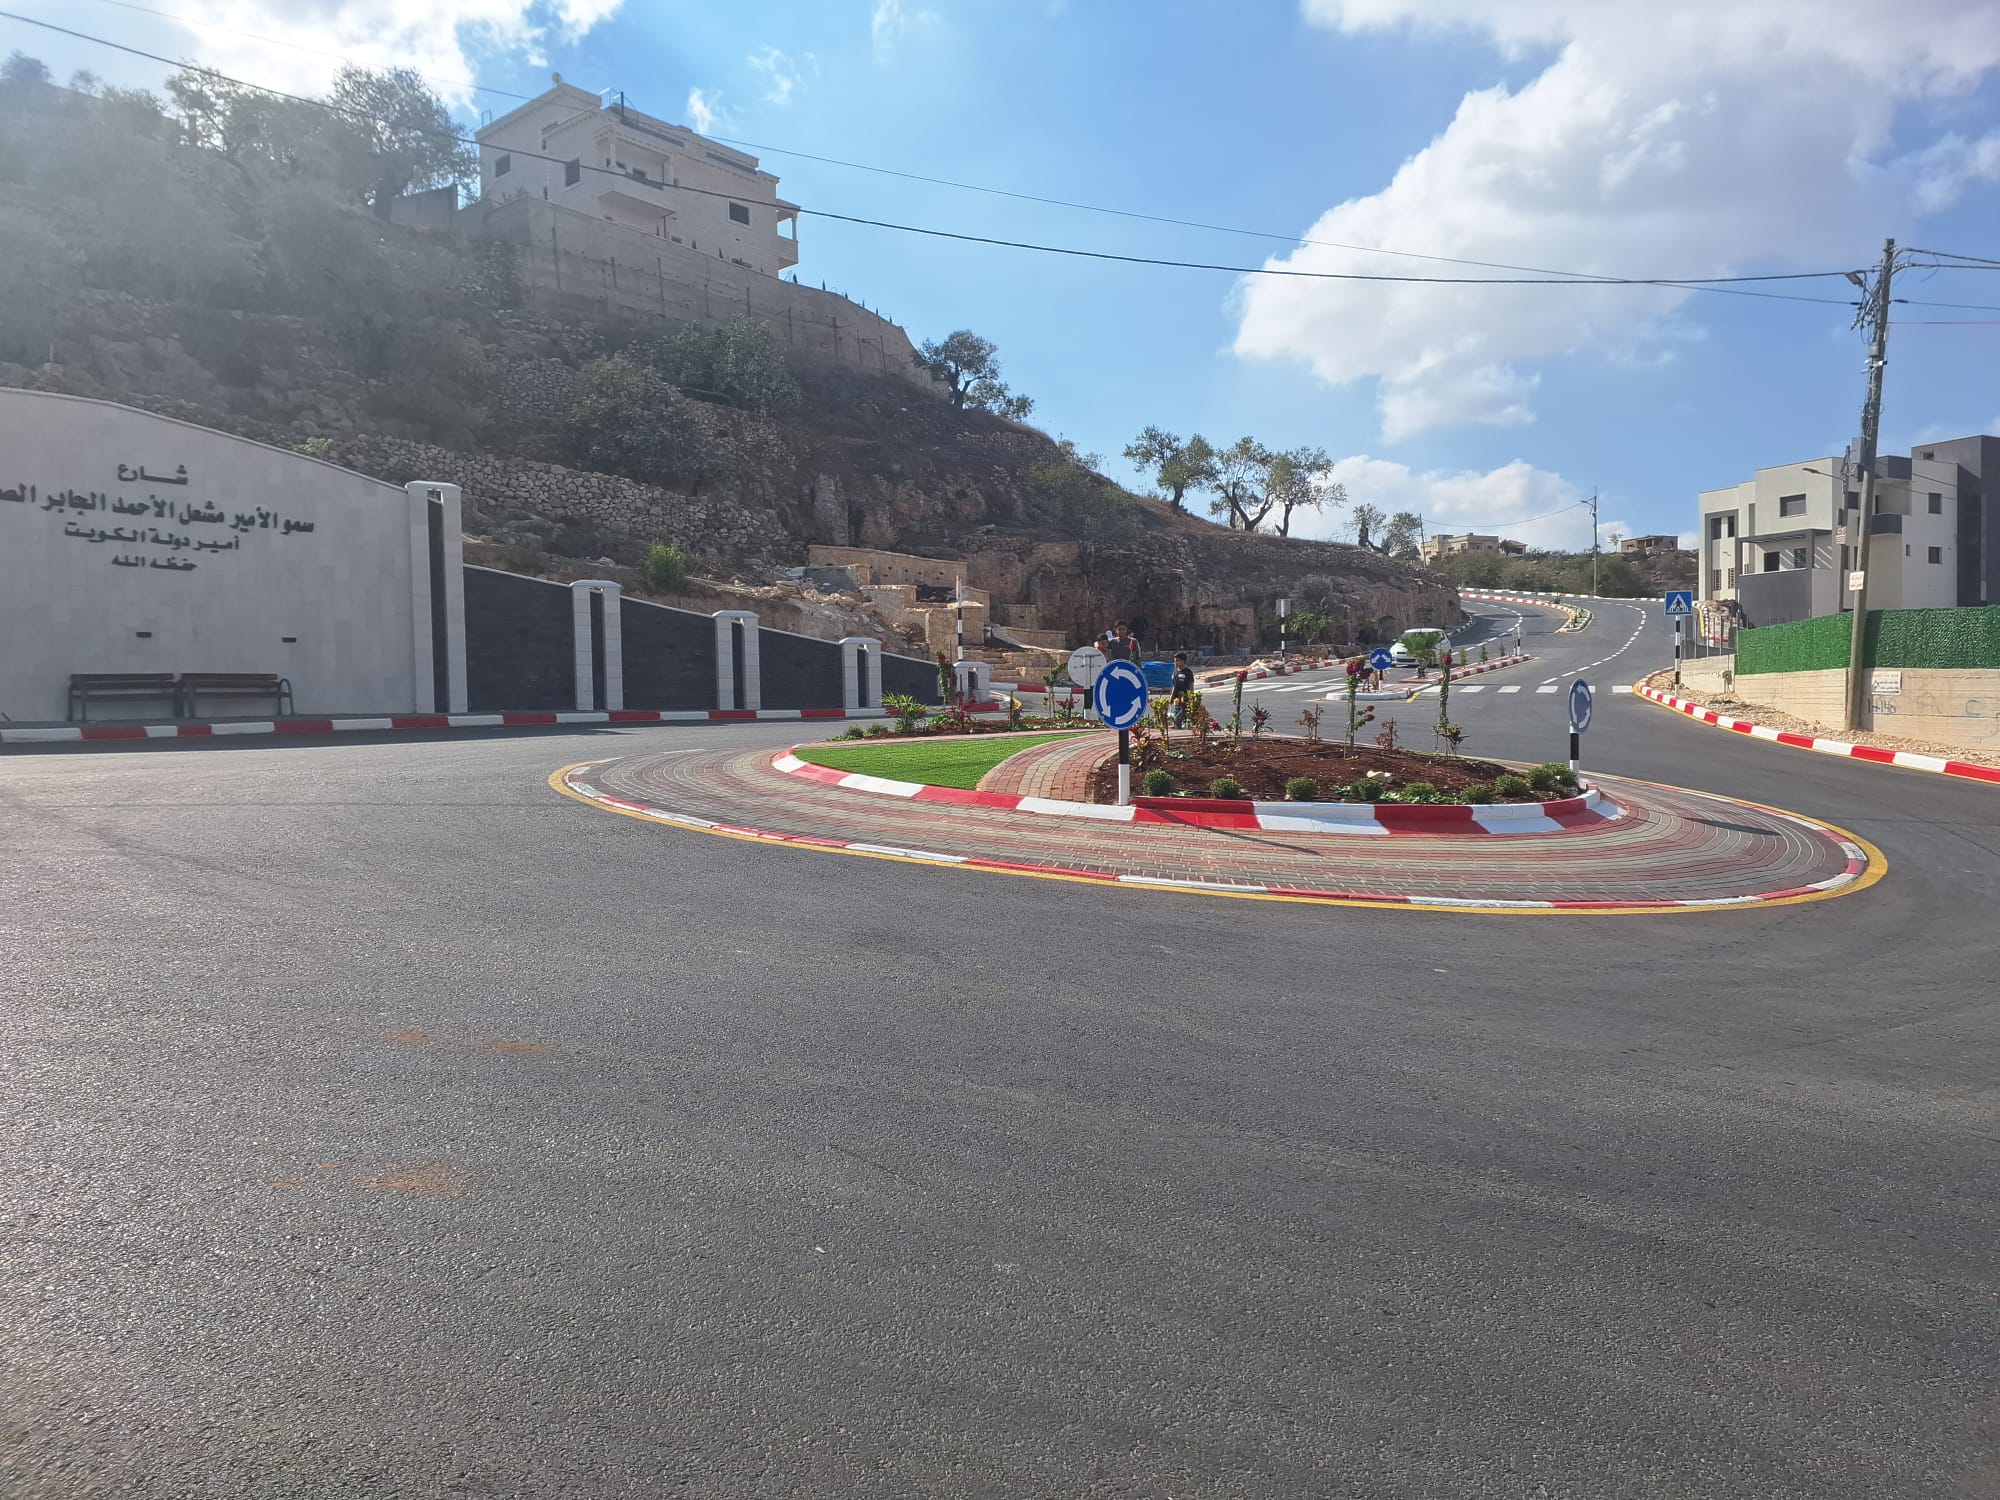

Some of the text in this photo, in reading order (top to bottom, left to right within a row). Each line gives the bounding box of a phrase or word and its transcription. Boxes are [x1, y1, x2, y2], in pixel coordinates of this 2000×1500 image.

[117, 463, 188, 486] شارع
[40, 488, 106, 516] الجابر
[112, 494, 174, 518] الأحمد
[179, 500, 225, 525] مشعل
[228, 505, 278, 533] الأمير
[279, 518, 314, 535] سمو
[65, 521, 239, 554] أمير دولة الكويت
[111, 554, 198, 571] حفظه الله
